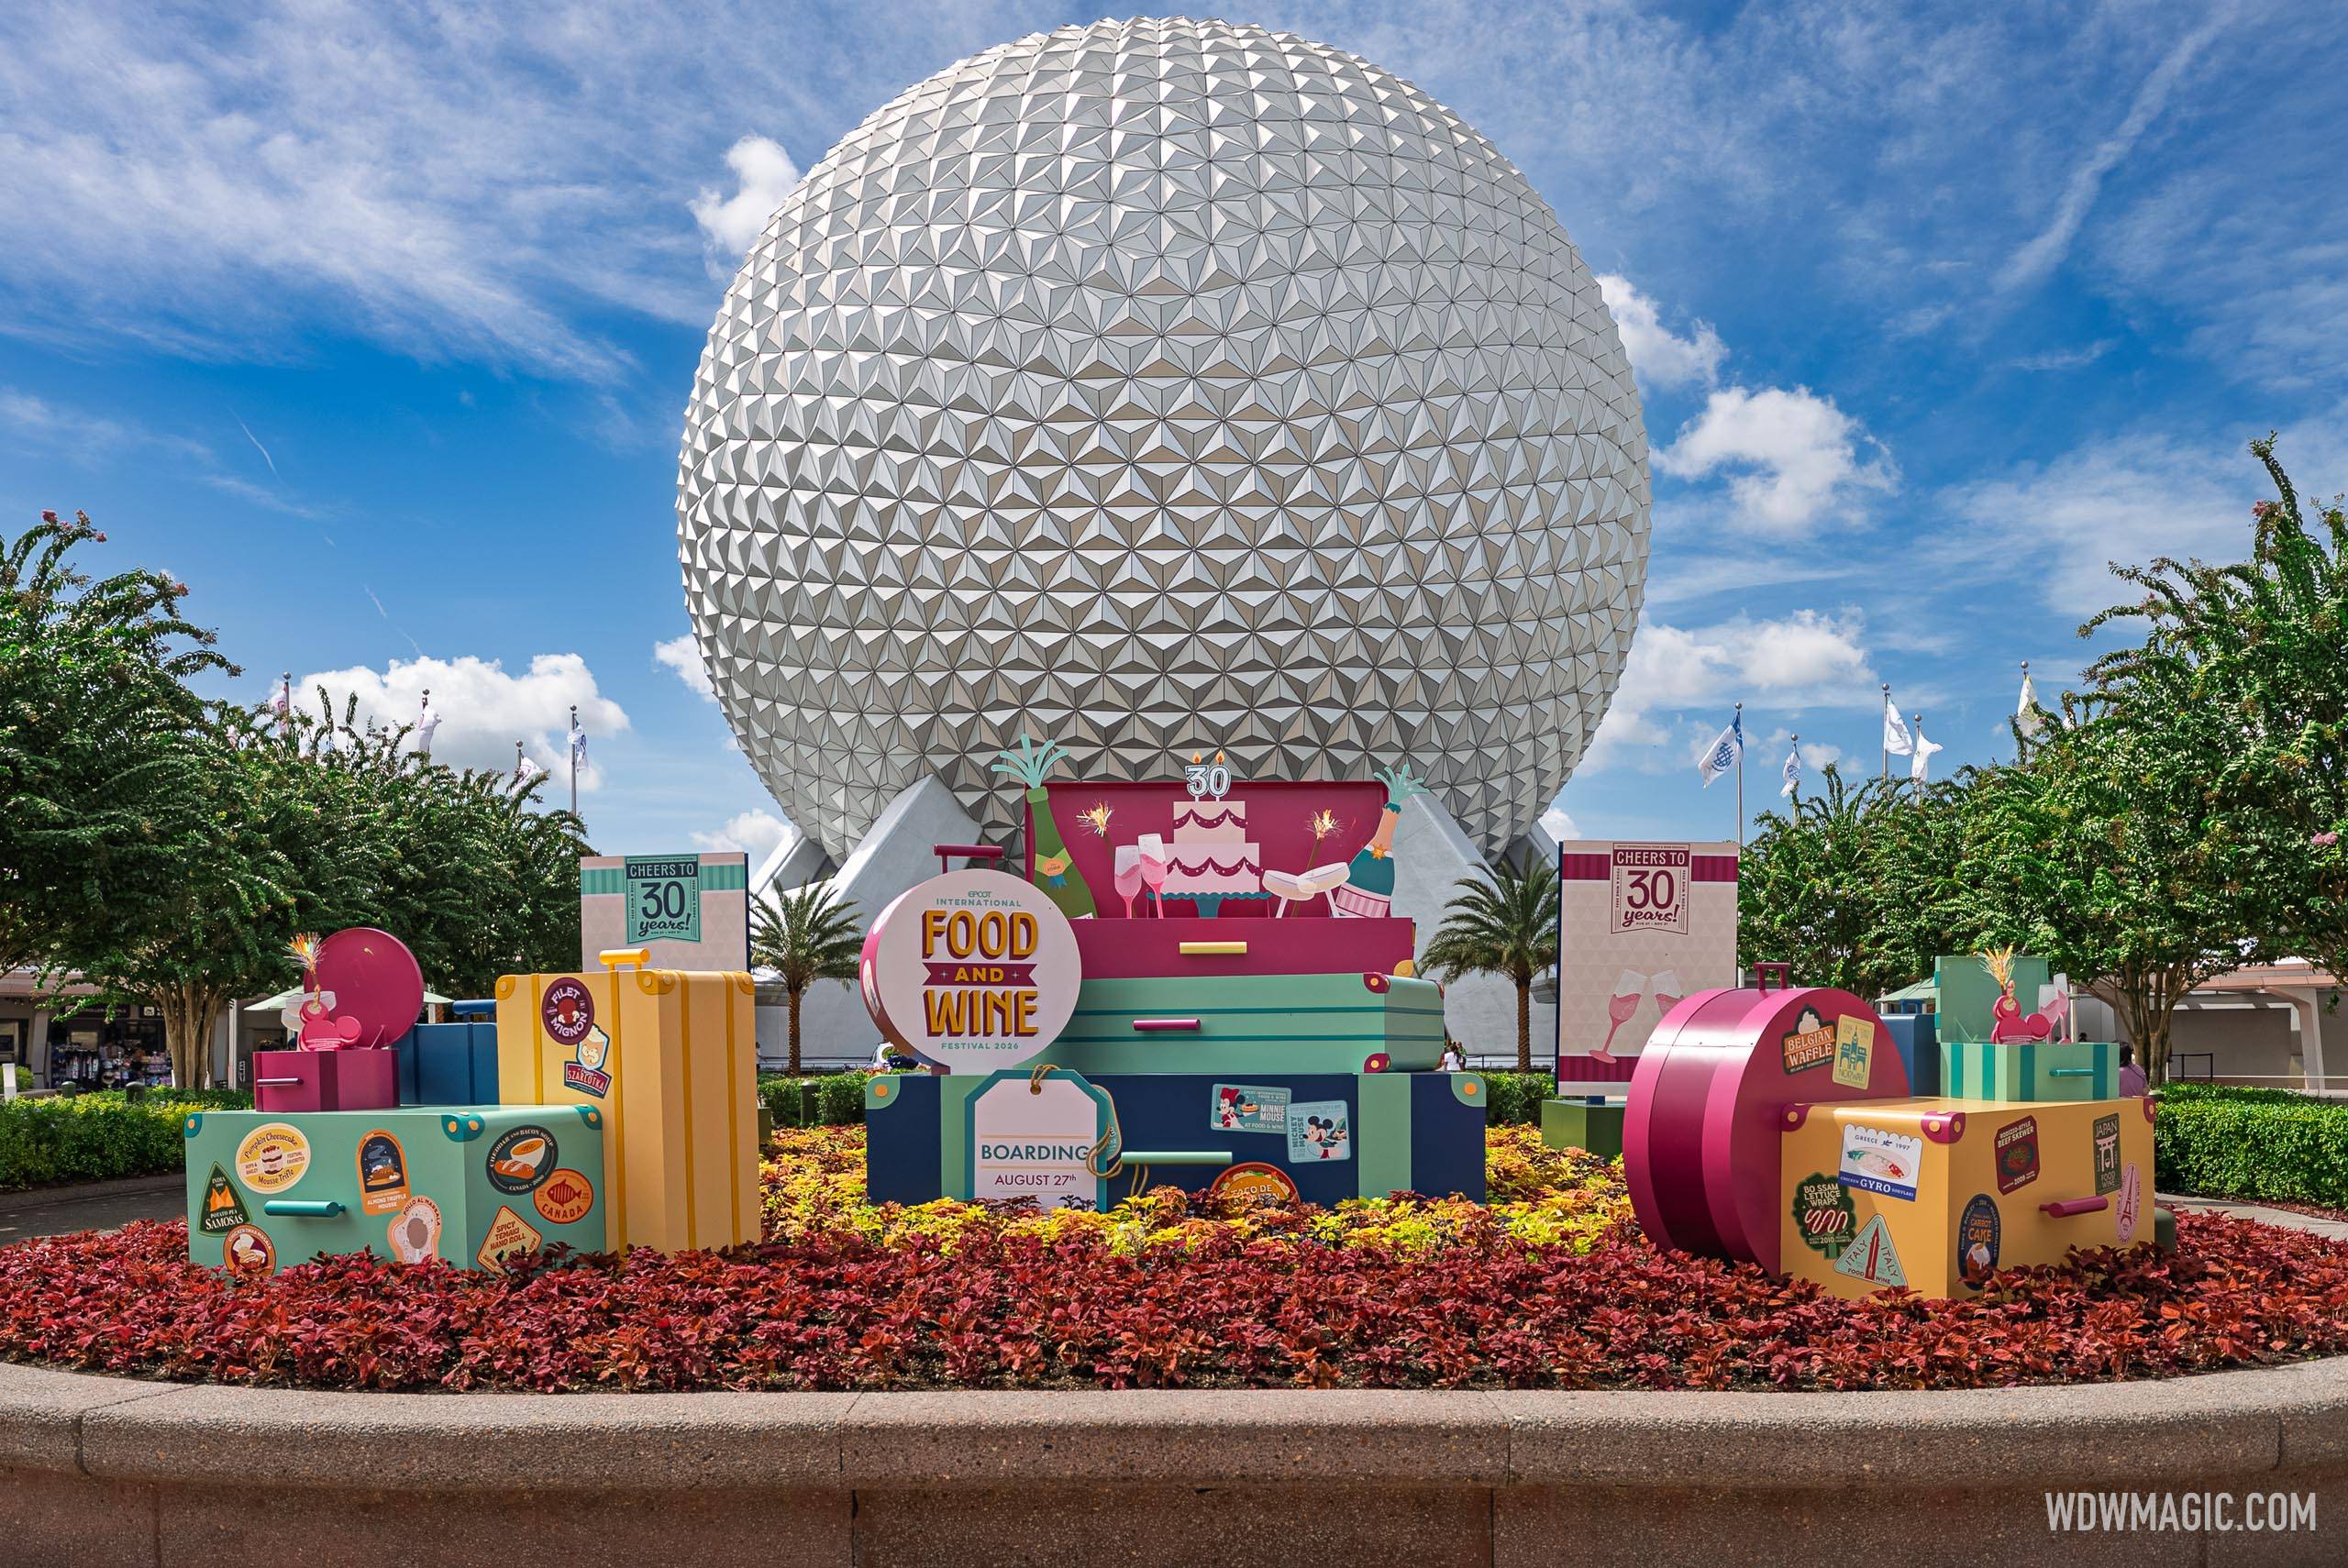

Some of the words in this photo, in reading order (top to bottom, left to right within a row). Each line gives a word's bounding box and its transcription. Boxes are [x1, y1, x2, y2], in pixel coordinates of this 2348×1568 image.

[1185, 765, 1231, 798] 30
[1617, 851, 1666, 865] CHEERS
[1670, 852, 1685, 865] TO
[630, 865, 676, 878] CHEERS
[680, 863, 694, 876] TO
[968, 890, 991, 899] EPCOT
[1627, 869, 1674, 909] 30
[641, 881, 685, 920] 30
[936, 899, 1022, 907] INTERNATIONAL
[1622, 904, 1680, 927] years!
[638, 912, 692, 937] years!
[922, 910, 1038, 960] FOOD
[955, 967, 1004, 982] AND
[551, 987, 580, 1004] FILET
[923, 989, 1038, 1037] WINE
[550, 1012, 587, 1037] MIGNON
[1788, 1029, 1831, 1051] BELGIAN
[1789, 1043, 1833, 1066] WAFFLE
[1839, 1070, 1865, 1081] NORWAY
[1259, 1111, 1284, 1122] MOUSE
[1260, 1103, 1285, 1115] MINNIE
[1290, 1116, 1299, 1148] MICKEY
[1298, 1117, 1306, 1147] MOUSE
[1998, 1136, 2011, 1148] BEEF
[2011, 1125, 2034, 1143] SKEWER
[2095, 1120, 2118, 1137] JAPAN
[244, 1136, 266, 1159] Pumpkin
[266, 1132, 298, 1148] Cheesecake
[489, 1136, 510, 1168] CHEDDAR
[520, 1128, 539, 1136] BACON
[540, 1132, 555, 1147] SOUP
[1855, 1134, 1877, 1144] GREECE
[1895, 1143, 1910, 1151] 1997
[981, 1144, 1090, 1160] BOARDING
[258, 1176, 279, 1185] Mousse
[279, 1168, 294, 1182] Trifle
[995, 1175, 1050, 1186] AUGUST
[1054, 1174, 1077, 1186] 27th
[1840, 1176, 1859, 1184] CHICKEN
[1860, 1178, 1891, 1193] GYRO
[2100, 1171, 2115, 1183] FOOD
[1259, 1184, 1273, 1192] DE
[1803, 1185, 1816, 1194] BO
[1817, 1182, 1840, 1193] SSAM
[1804, 1189, 1842, 1200] LETTUCE
[367, 1197, 386, 1205] ALMOND
[386, 1193, 407, 1201] TRUFFLE
[1810, 1197, 1838, 1207] WRAPS
[210, 1209, 228, 1219] POTATO
[404, 1199, 416, 1216] POLLO
[542, 1203, 583, 1219] CANADA
[205, 1214, 244, 1231] SAMOSAS
[496, 1220, 515, 1232] SPICY
[1970, 1218, 1992, 1228] CARROT
[490, 1238, 508, 1251] HAND
[509, 1232, 526, 1243] ROLL
[495, 1227, 520, 1241] TEMAKI
[1821, 1236, 1834, 1244] 2010
[1968, 1227, 1992, 1242] CAKE
[1845, 1239, 1867, 1265] ITALY
[1881, 1247, 1899, 1276] ITALY
[1847, 1268, 1865, 1276] FOOD
[1876, 1275, 1891, 1285] WINE
